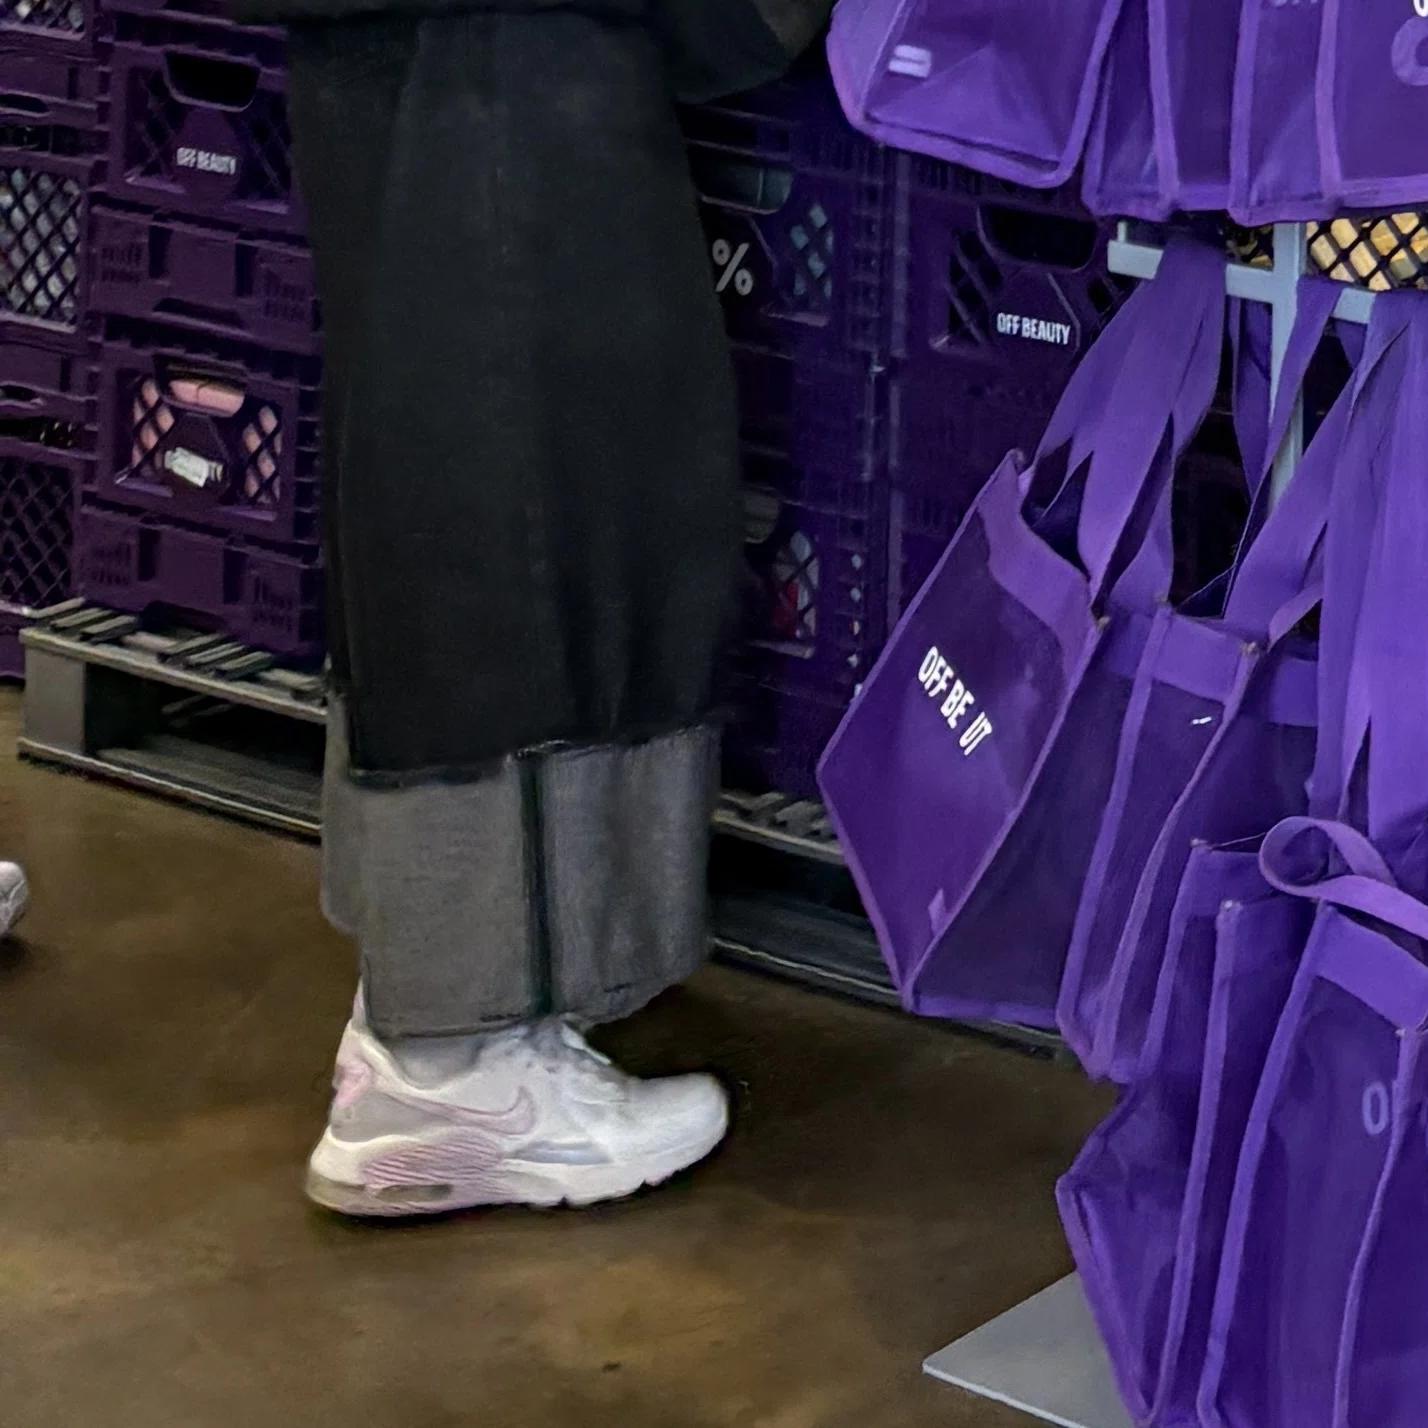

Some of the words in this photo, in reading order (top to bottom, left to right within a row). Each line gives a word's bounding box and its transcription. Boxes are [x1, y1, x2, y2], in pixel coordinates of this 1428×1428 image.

[712, 238, 754, 296] %
[996, 312, 1021, 337] OFF
[1021, 317, 1071, 346] BEAUTY
[917, 645, 954, 700] OFF
